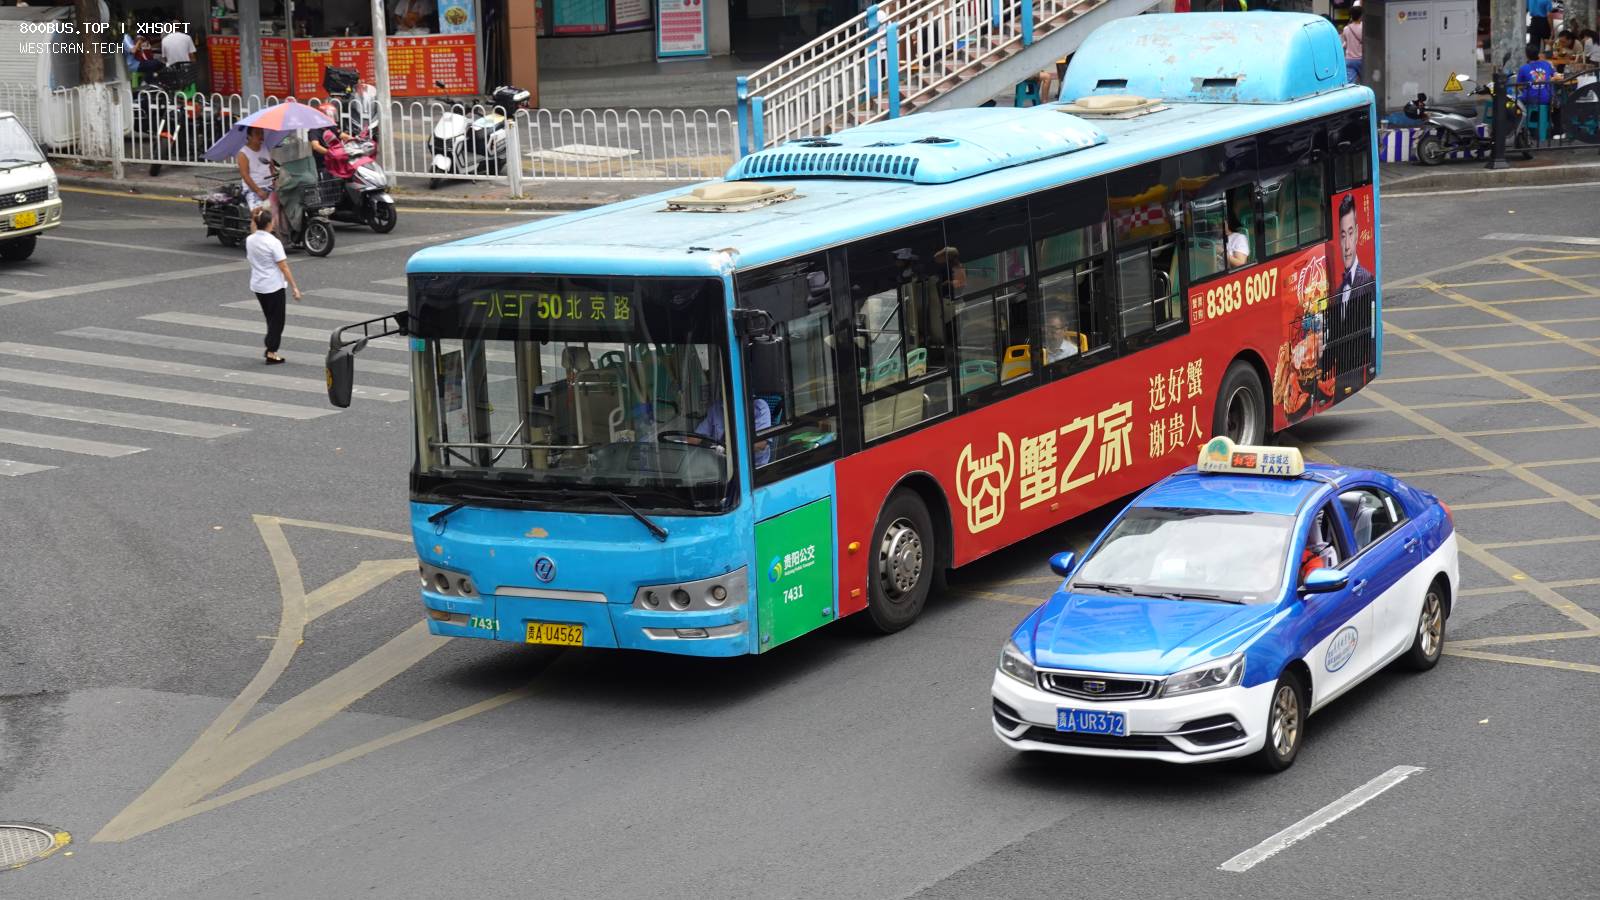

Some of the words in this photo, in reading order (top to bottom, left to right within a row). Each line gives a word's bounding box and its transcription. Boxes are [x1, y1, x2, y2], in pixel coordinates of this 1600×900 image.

[473, 291, 533, 318] 一八三厂
[537, 293, 563, 319] 50
[567, 295, 630, 320] 北京路
[1206, 280, 1242, 319] 8383
[1245, 267, 1278, 305] 6007
[1149, 357, 1203, 413] 选好蟹
[1149, 405, 1203, 459] 谢贵人
[1020, 400, 1133, 511] 蟹之家
[1260, 464, 1291, 474] TAXI
[783, 544, 816, 570] 贵阳公交
[783, 584, 804, 604] 7431
[471, 617, 500, 631] 7431
